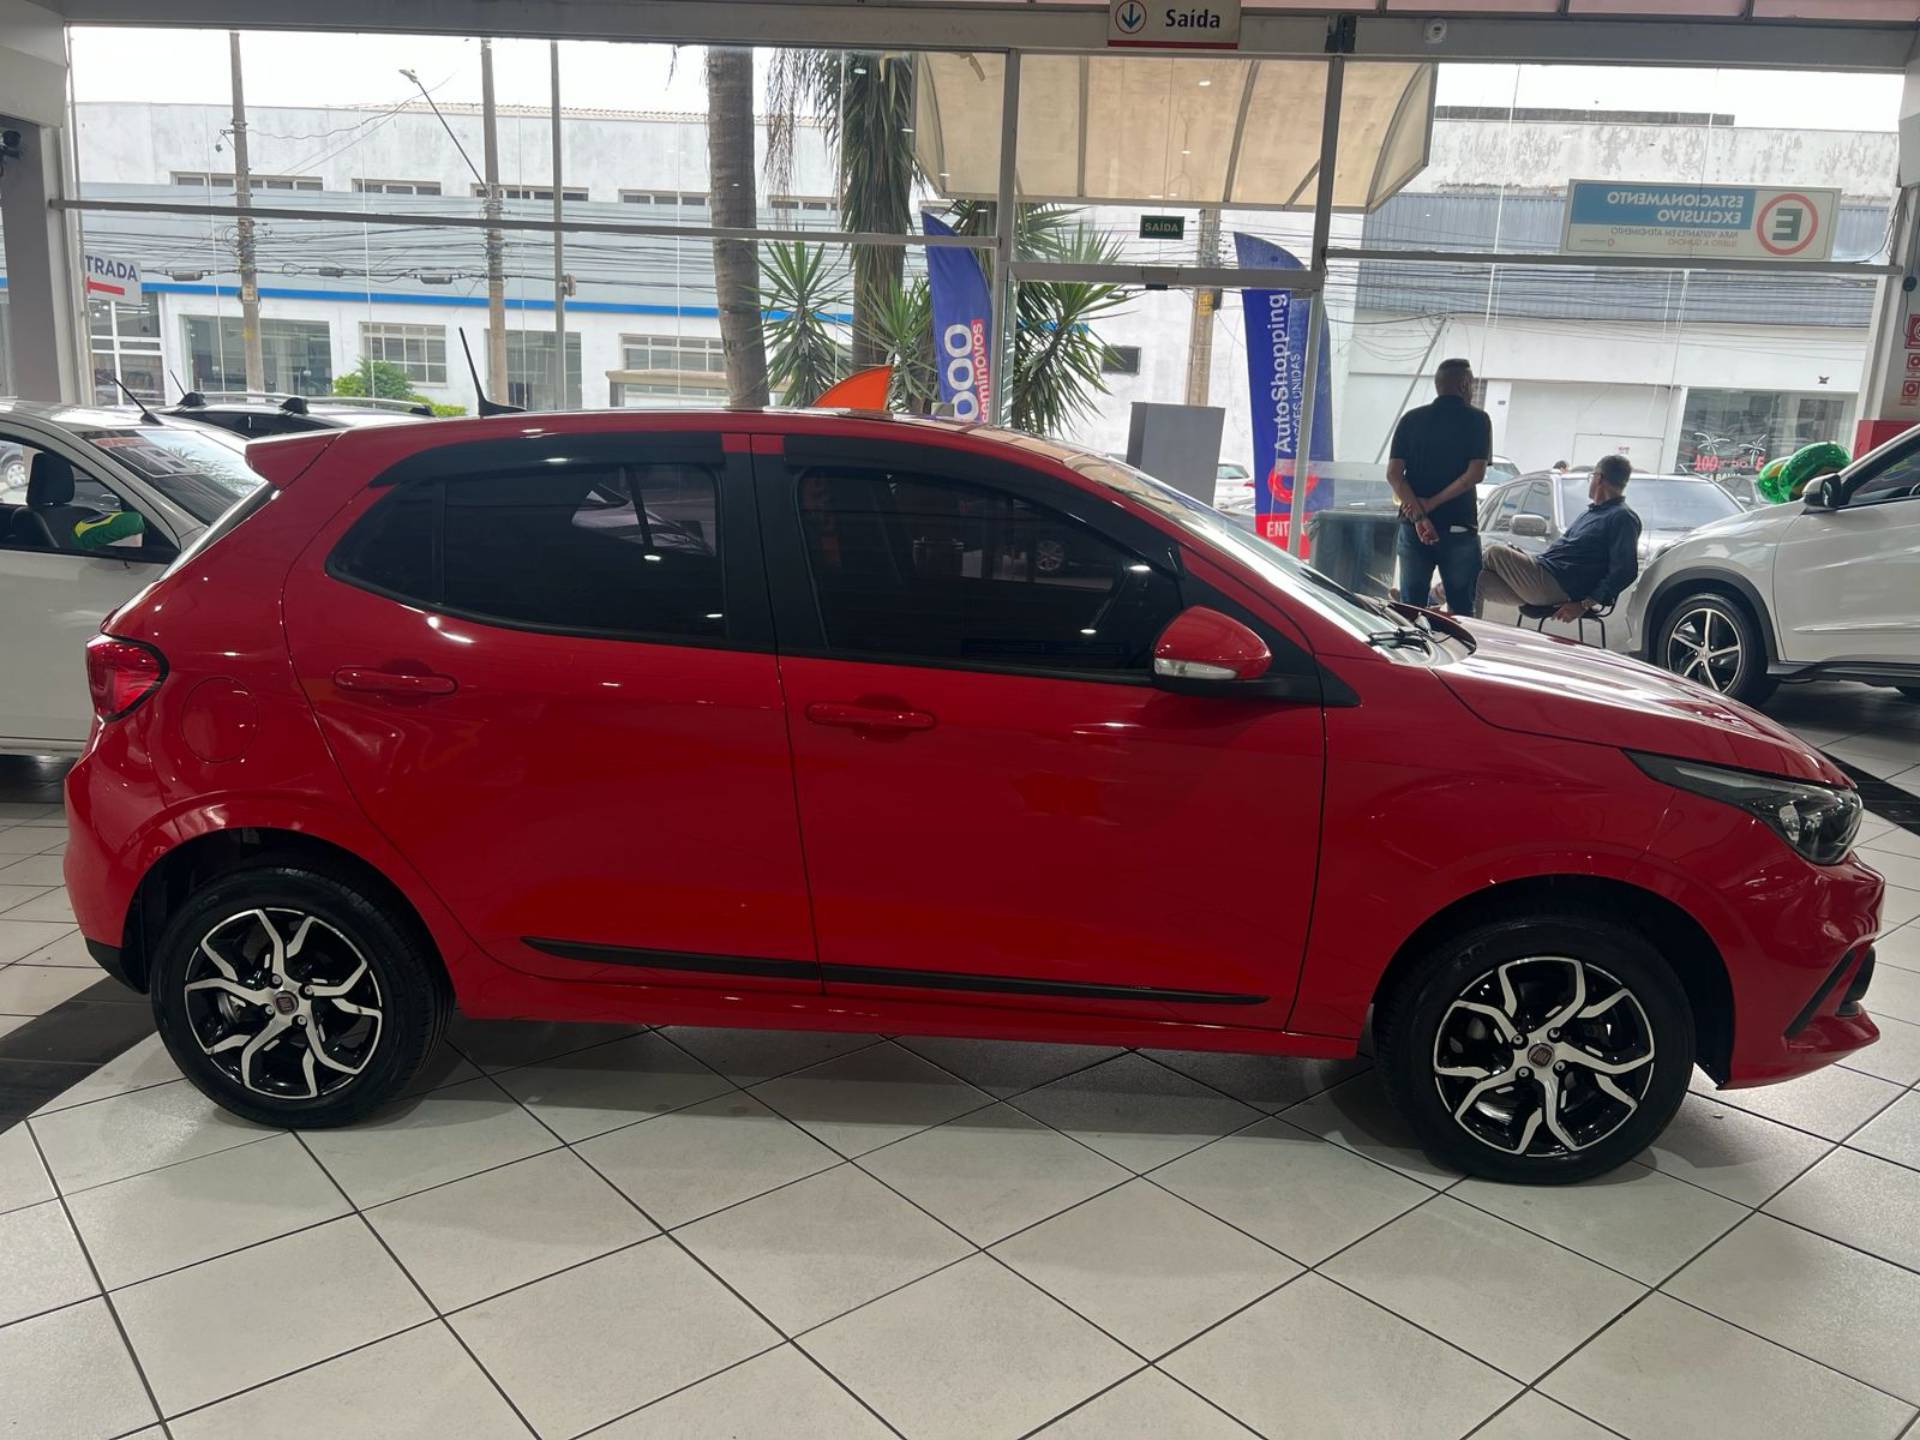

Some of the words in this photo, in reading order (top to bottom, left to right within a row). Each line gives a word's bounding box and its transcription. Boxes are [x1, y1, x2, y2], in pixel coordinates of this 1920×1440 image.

[1165, 8, 1221, 28] Saída
[85, 255, 138, 282] TRADA
[944, 324, 979, 422] 000
[1267, 294, 1292, 453] AutoShopping
[1290, 352, 1303, 400] UNIDAS
